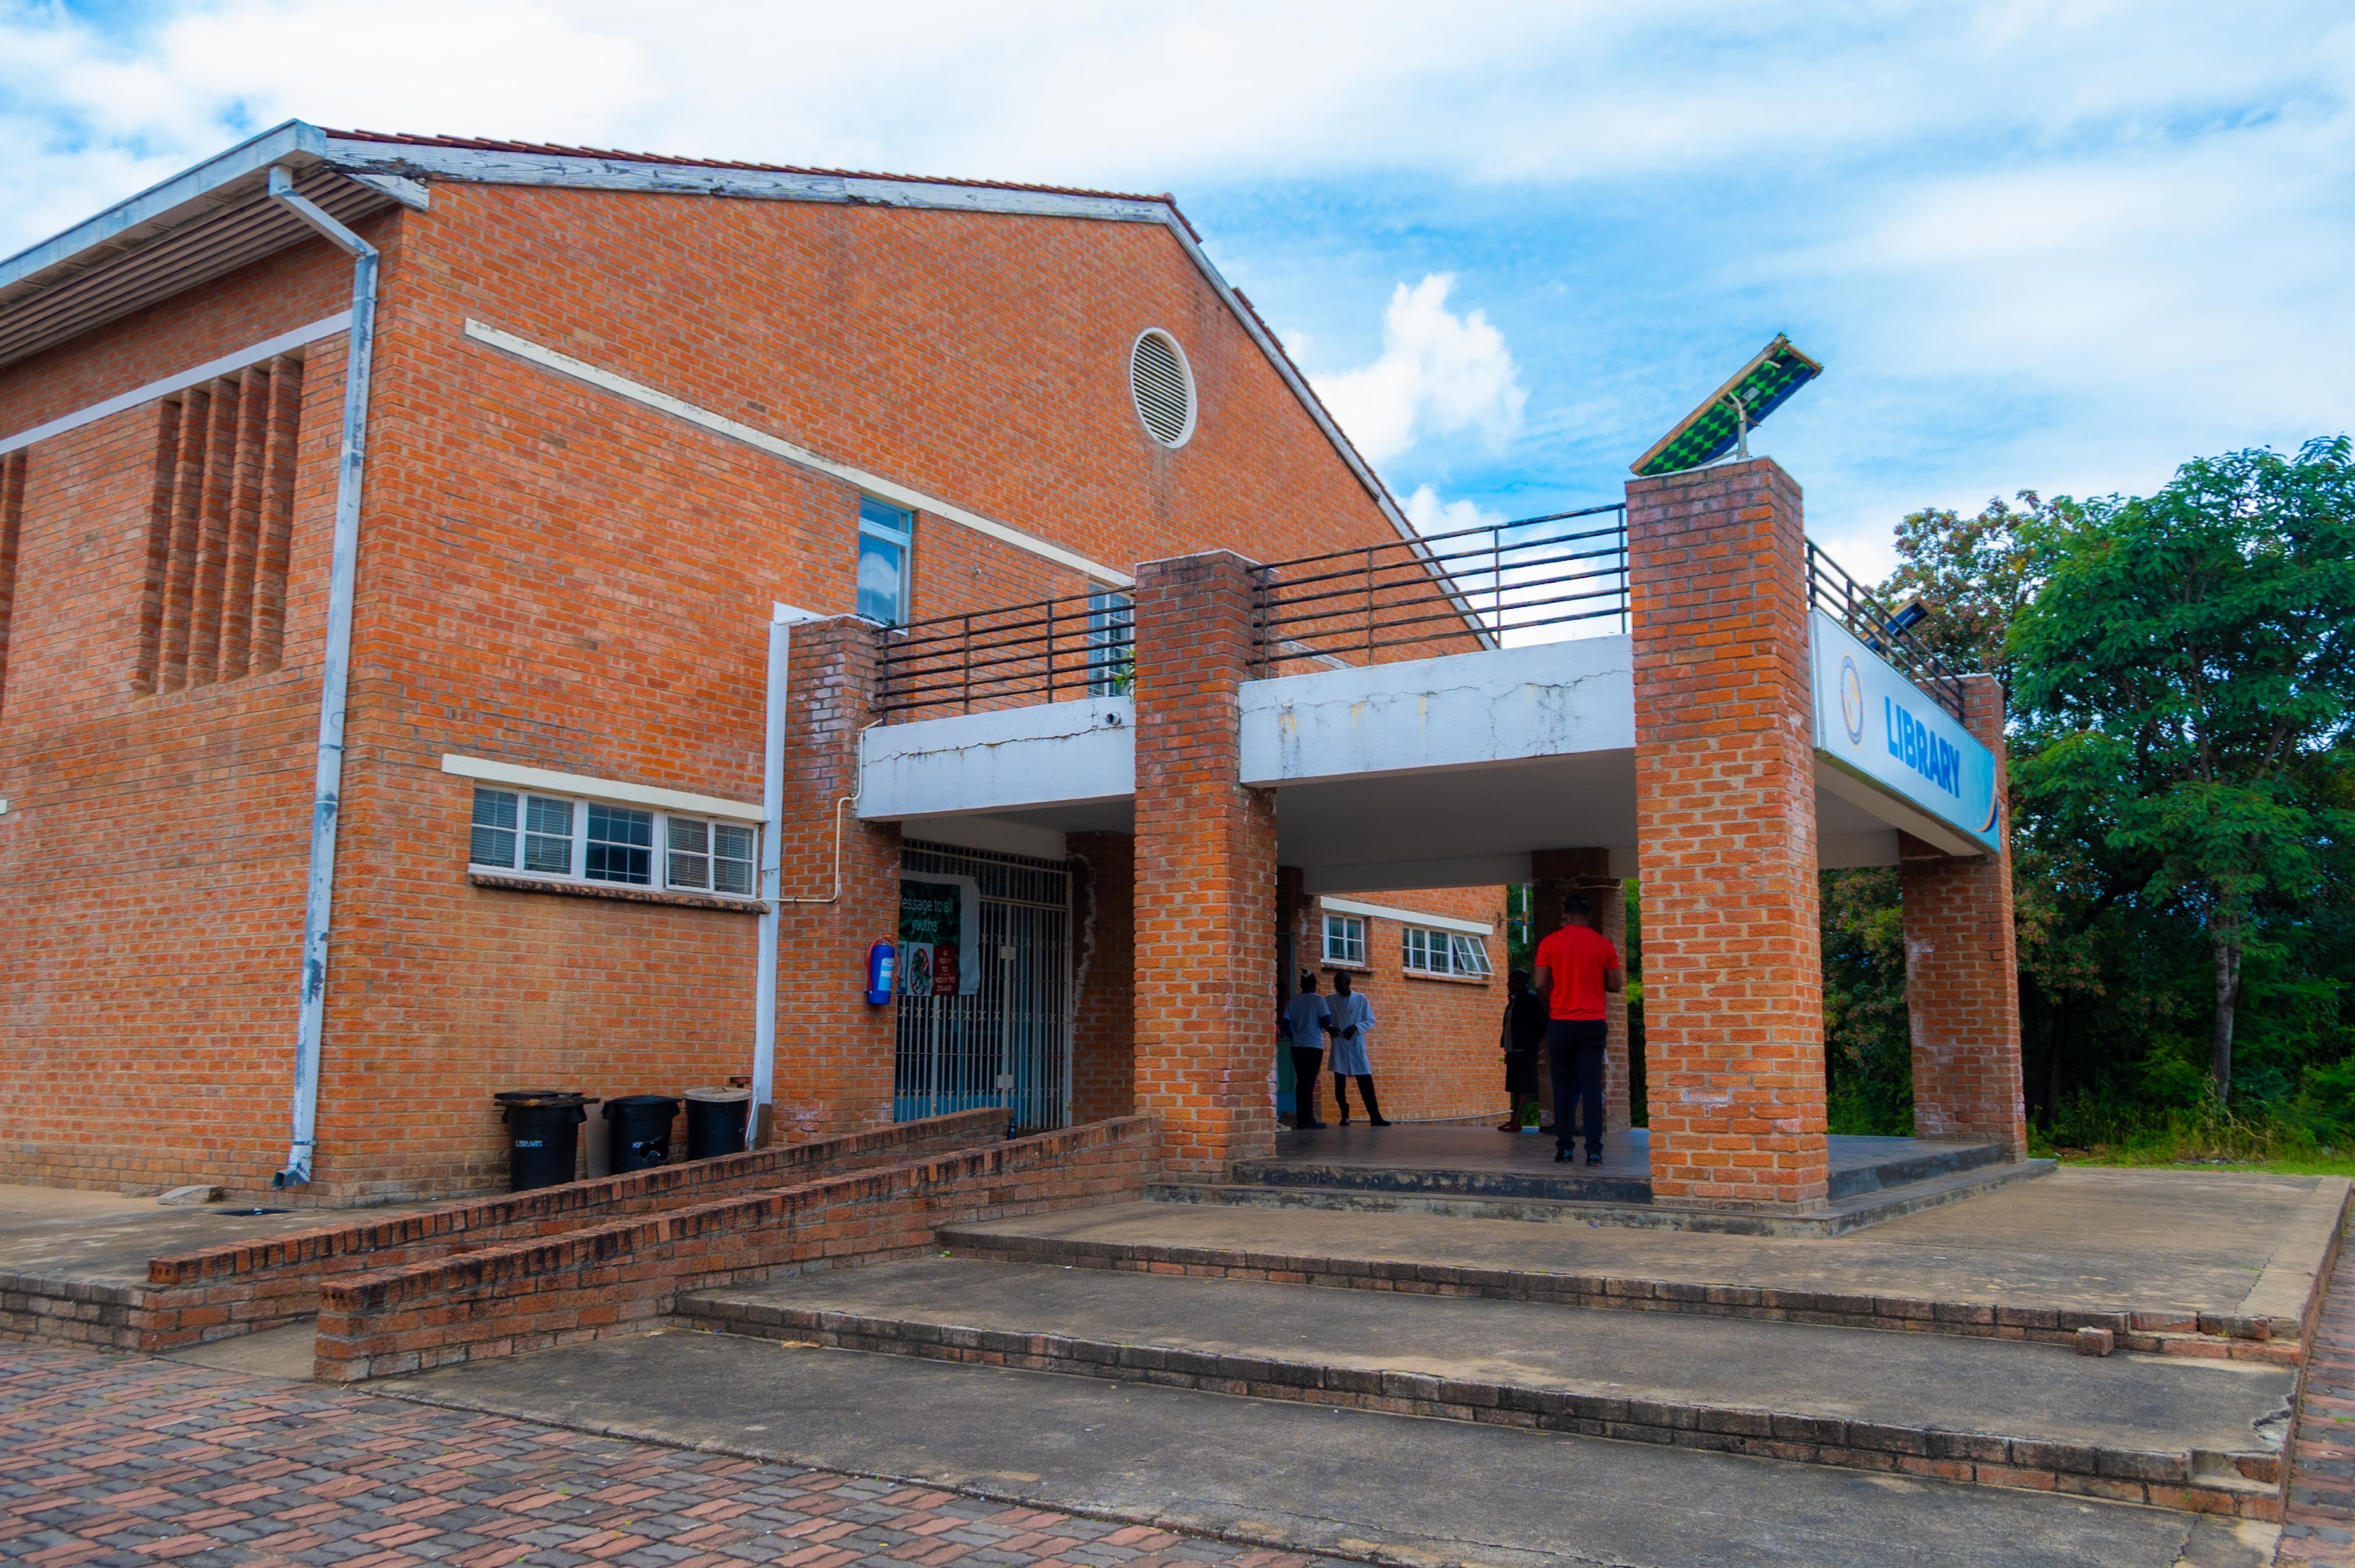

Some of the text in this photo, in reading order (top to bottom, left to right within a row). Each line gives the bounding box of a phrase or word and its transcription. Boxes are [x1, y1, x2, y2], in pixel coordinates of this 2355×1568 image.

[1885, 696, 1960, 798] LIBRARY
[934, 900, 942, 912] to
[944, 897, 954, 913] all
[910, 916, 938, 934] youths
